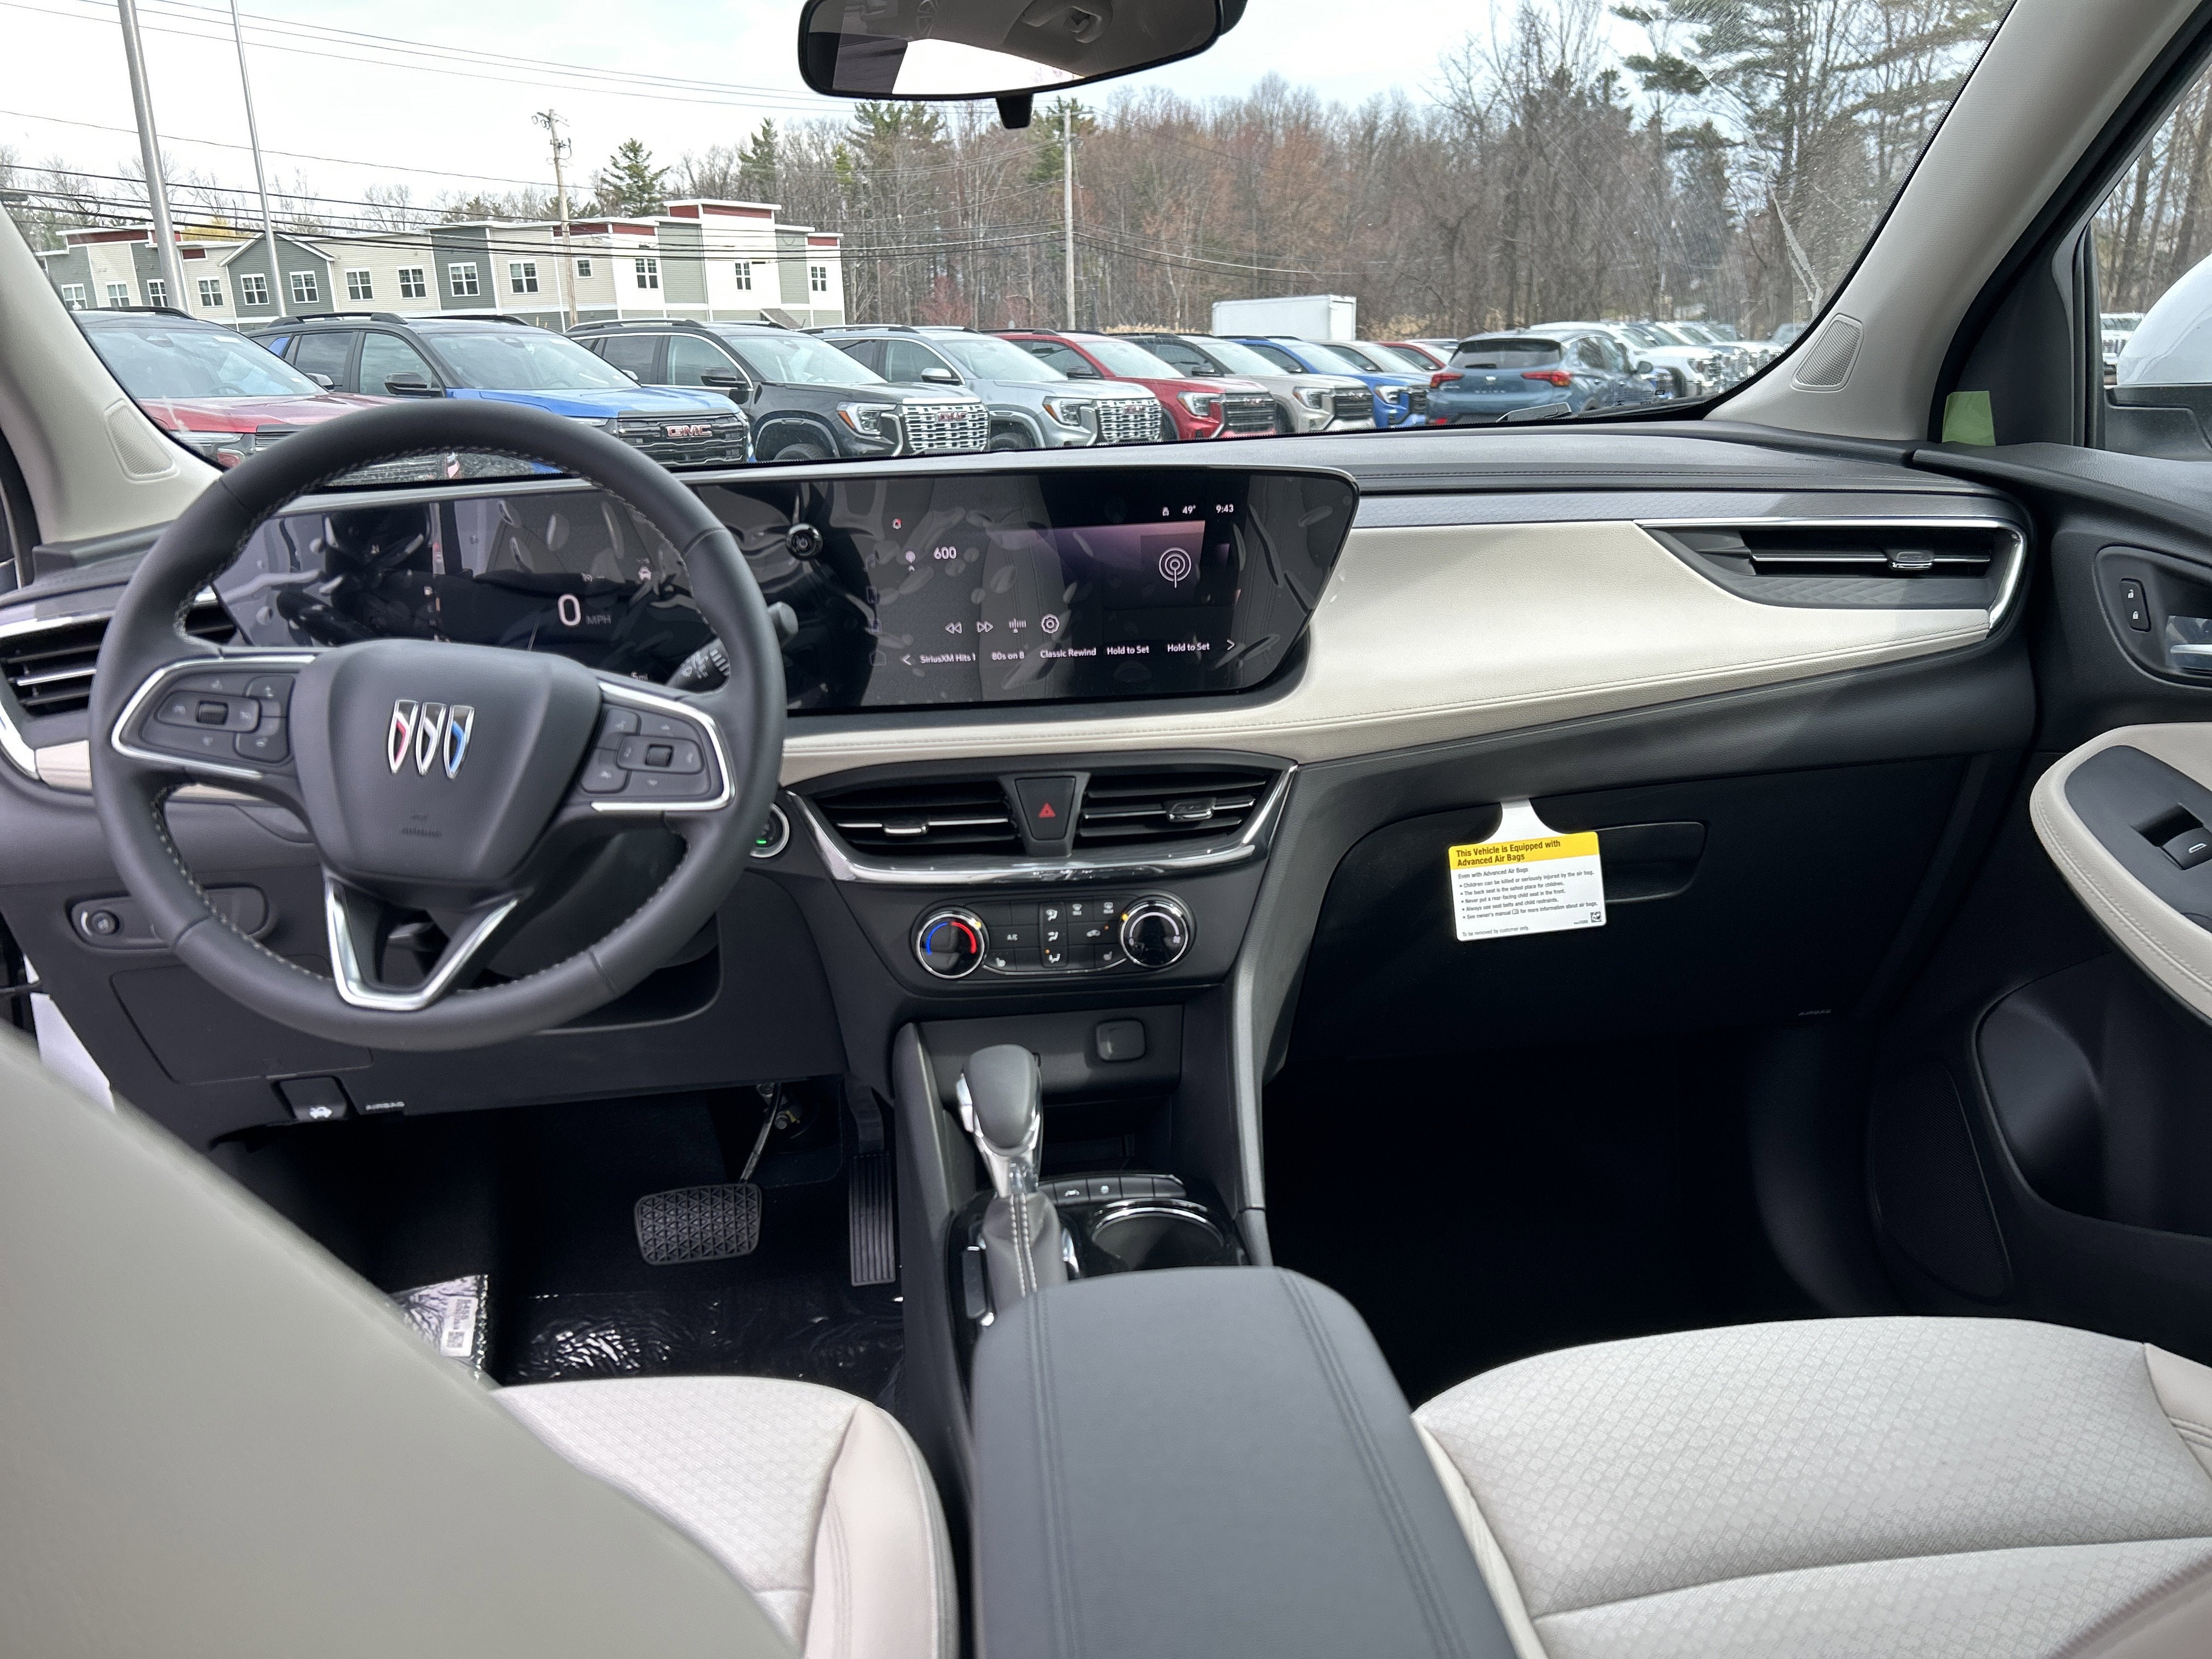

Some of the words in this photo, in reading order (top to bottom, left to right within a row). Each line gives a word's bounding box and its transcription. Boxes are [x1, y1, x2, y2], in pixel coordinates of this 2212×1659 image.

[667, 424, 712, 437] GMC
[1216, 504, 1234, 514] 9:43
[934, 546, 957, 560] 600
[557, 594, 582, 627] 0
[585, 615, 611, 624] MPH
[1040, 649, 1067, 658] Classic
[1068, 647, 1097, 657] Rewind
[1107, 646, 1125, 655] Hold
[1126, 646, 1135, 654] to
[1136, 645, 1150, 653] Set
[1167, 643, 1186, 652] Hold
[1187, 642, 1195, 651] to
[1197, 642, 1210, 651] Set
[920, 653, 955, 664] SiriusXM
[955, 653, 972, 662] Hits
[991, 651, 1007, 661] 80s
[1455, 849, 1471, 857] This
[1473, 846, 1499, 855] Vehicle
[1509, 842, 1543, 853] Equipped
[1544, 839, 1560, 848] with
[1457, 856, 1492, 866] Advanced
[1494, 854, 1505, 862] Air
[1506, 853, 1525, 862] Bags
[365, 1102, 405, 1110] AIRBAG
